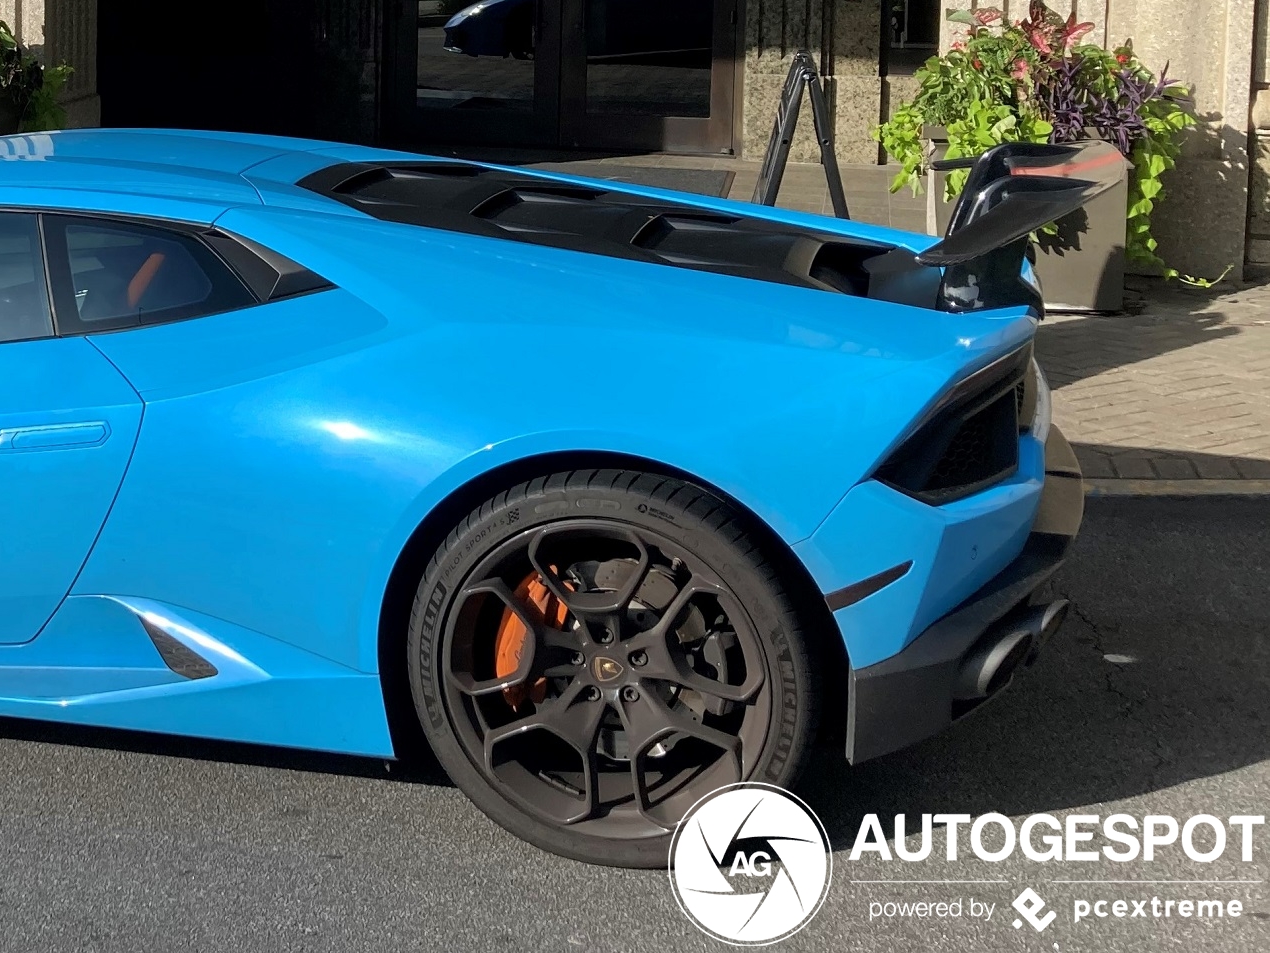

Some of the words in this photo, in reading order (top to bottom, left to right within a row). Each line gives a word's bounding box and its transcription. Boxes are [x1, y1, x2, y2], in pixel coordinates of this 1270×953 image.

[444, 551, 463, 577] PILOT
[465, 526, 492, 551] SPORT
[420, 585, 444, 698] MICHELIN
[767, 660, 796, 779] MICHELIN
